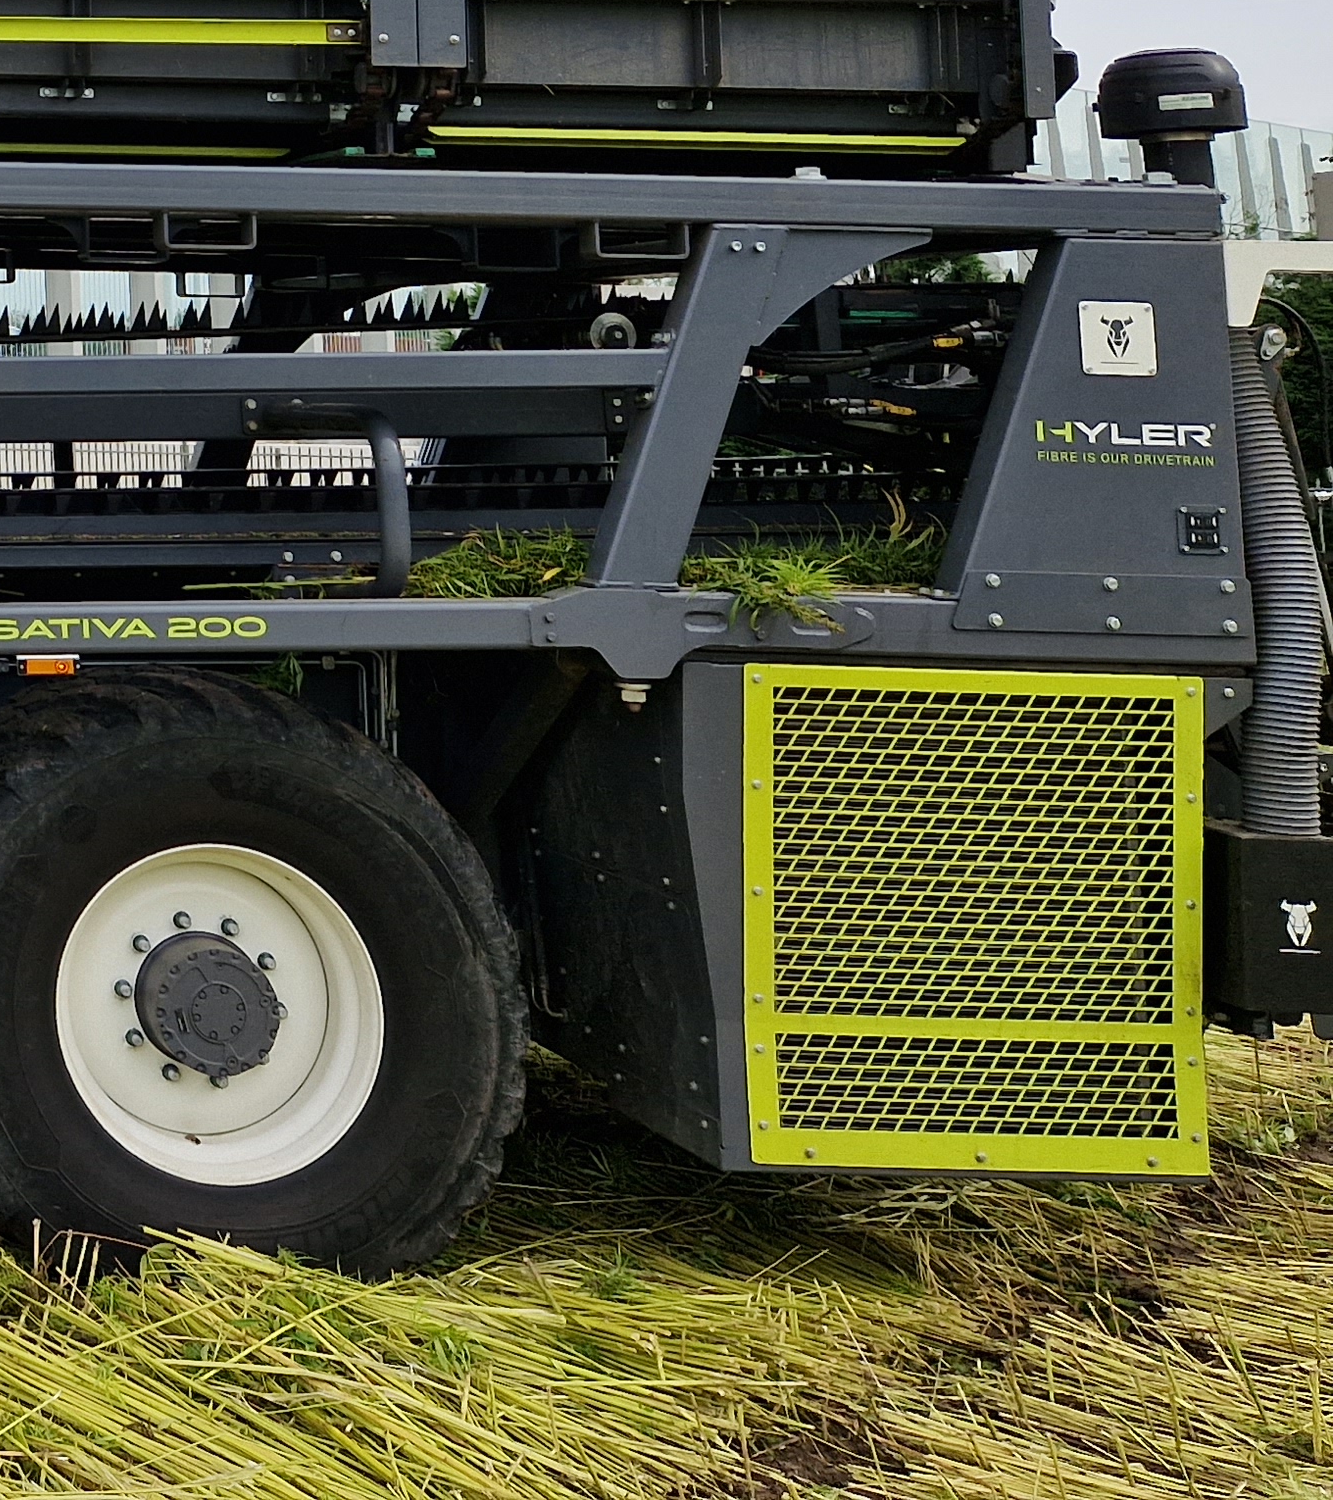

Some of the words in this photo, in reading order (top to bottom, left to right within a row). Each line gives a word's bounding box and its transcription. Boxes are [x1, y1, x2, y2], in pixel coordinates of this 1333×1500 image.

[1035, 419, 1213, 447] HYLER
[1037, 450, 1078, 463] FIBRE
[1083, 452, 1096, 464] IS
[1100, 452, 1130, 465] OUR
[1134, 453, 1215, 467] DRIVETRAIN
[167, 616, 269, 639] 200
